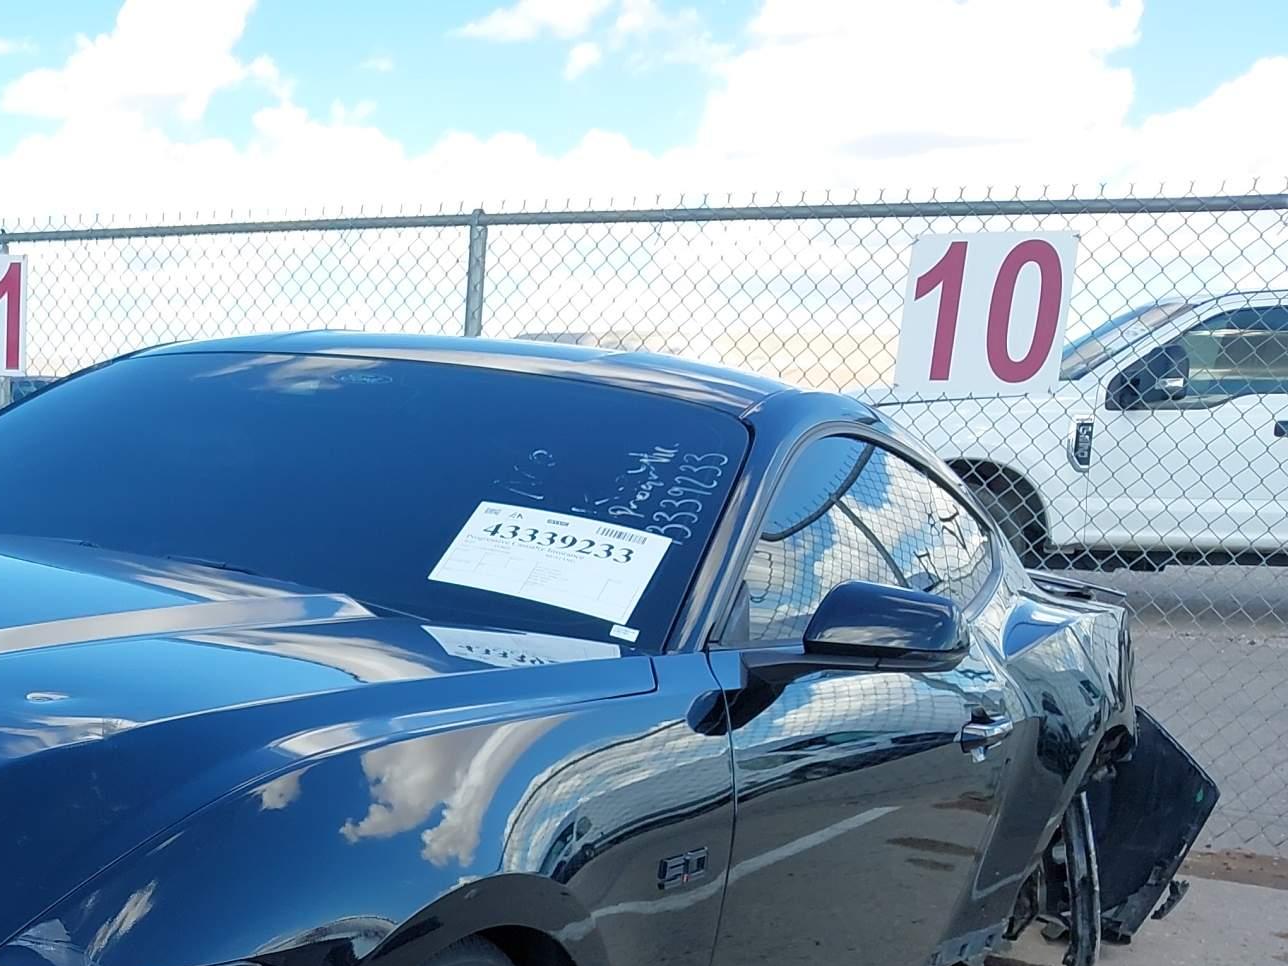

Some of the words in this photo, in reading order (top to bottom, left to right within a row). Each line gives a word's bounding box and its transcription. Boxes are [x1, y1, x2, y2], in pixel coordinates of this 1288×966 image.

[914, 239, 1062, 383] 10
[483, 523, 634, 564] 43339233
[646, 452, 729, 546] 3339233
